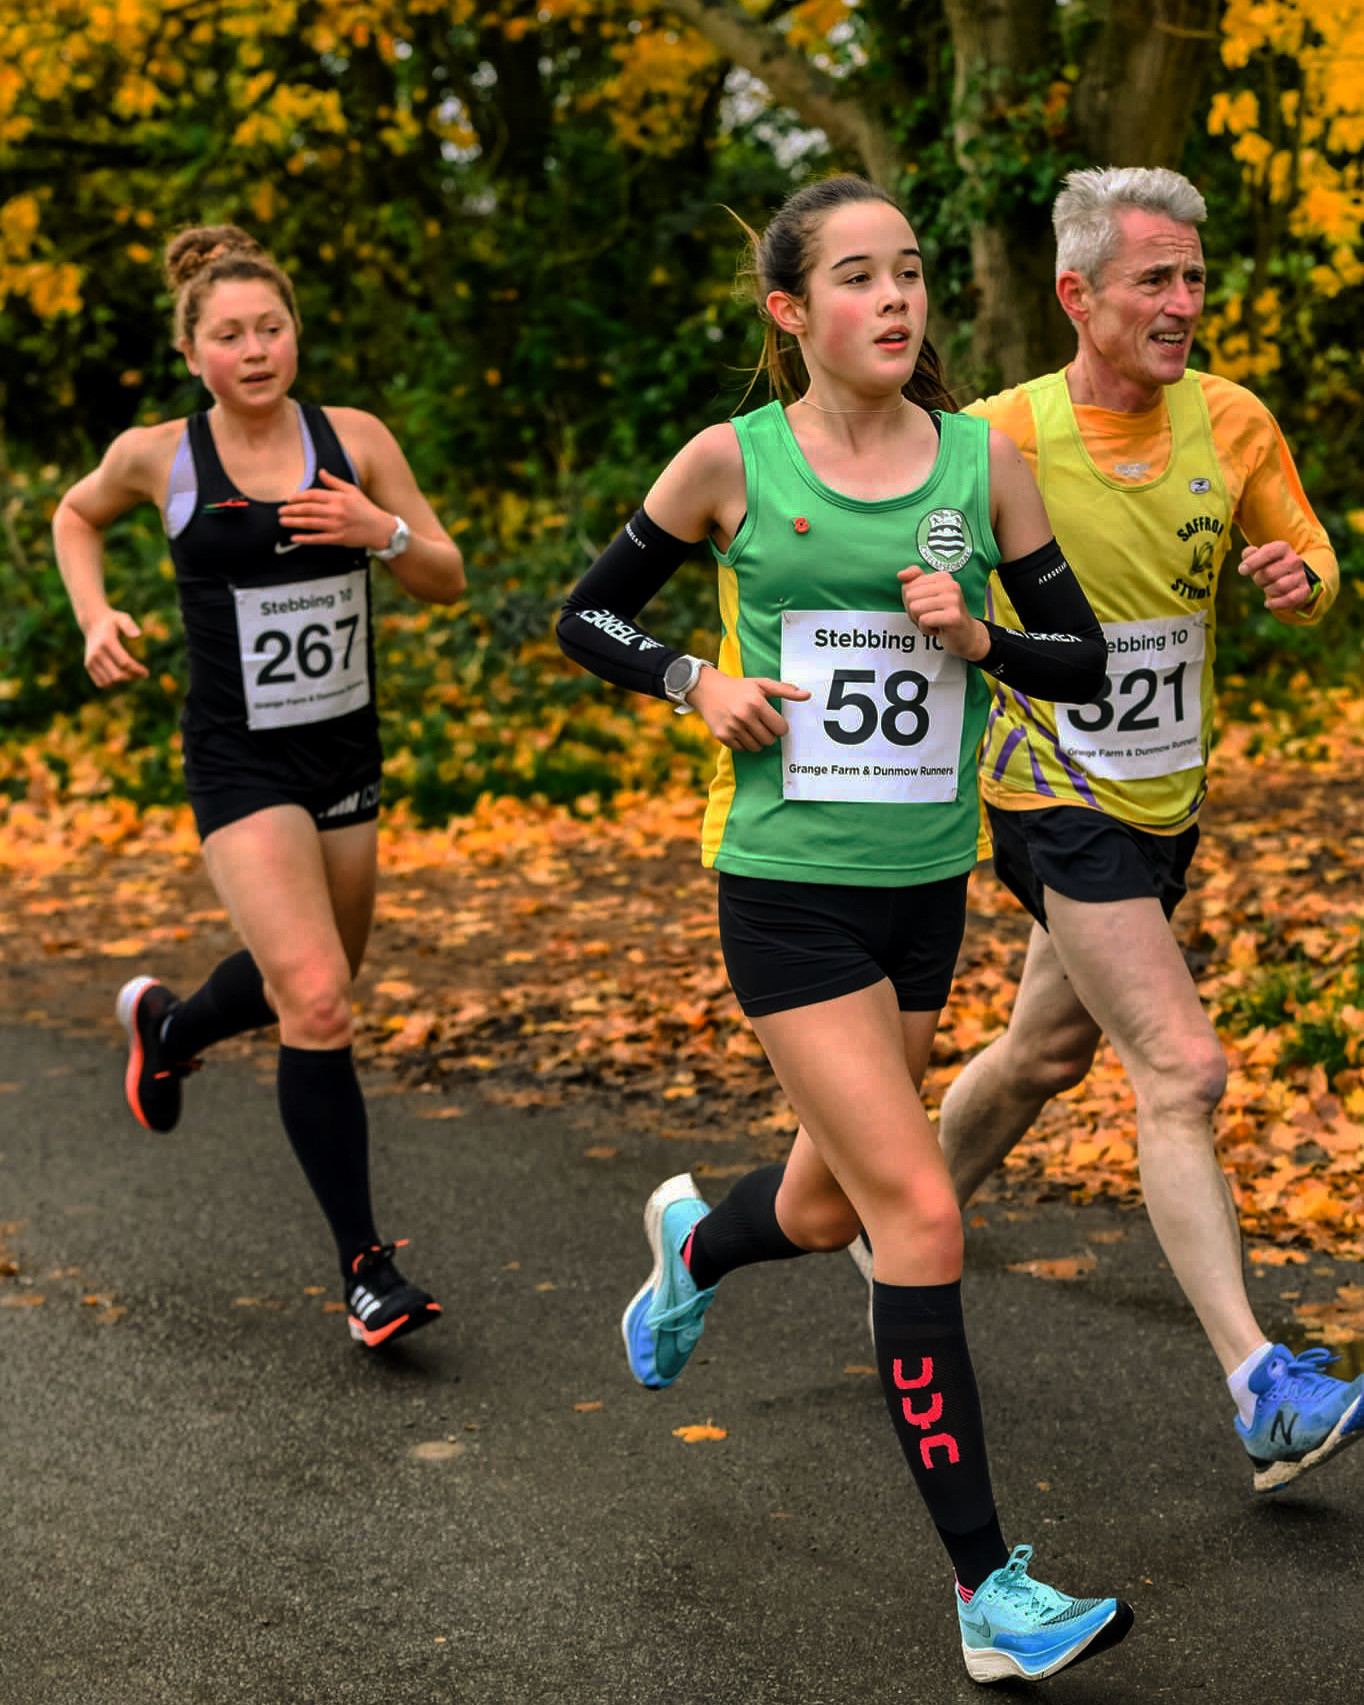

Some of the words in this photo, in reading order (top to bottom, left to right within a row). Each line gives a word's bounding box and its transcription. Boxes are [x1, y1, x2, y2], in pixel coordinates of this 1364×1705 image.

[260, 594, 335, 616] Stebbing
[254, 614, 360, 686] 267
[814, 629, 916, 653] Stebbing
[1107, 634, 1166, 654] ebbing
[1171, 629, 1188, 646] 10
[823, 669, 930, 746] 58
[1067, 661, 1187, 732] 321
[1099, 748, 1124, 759] Farm
[1126, 747, 1133, 757] &
[788, 763, 829, 776] Grange
[831, 764, 861, 776] Farm
[863, 765, 871, 776] &
[873, 765, 919, 777] Dunmow
[920, 766, 954, 776] Runners
